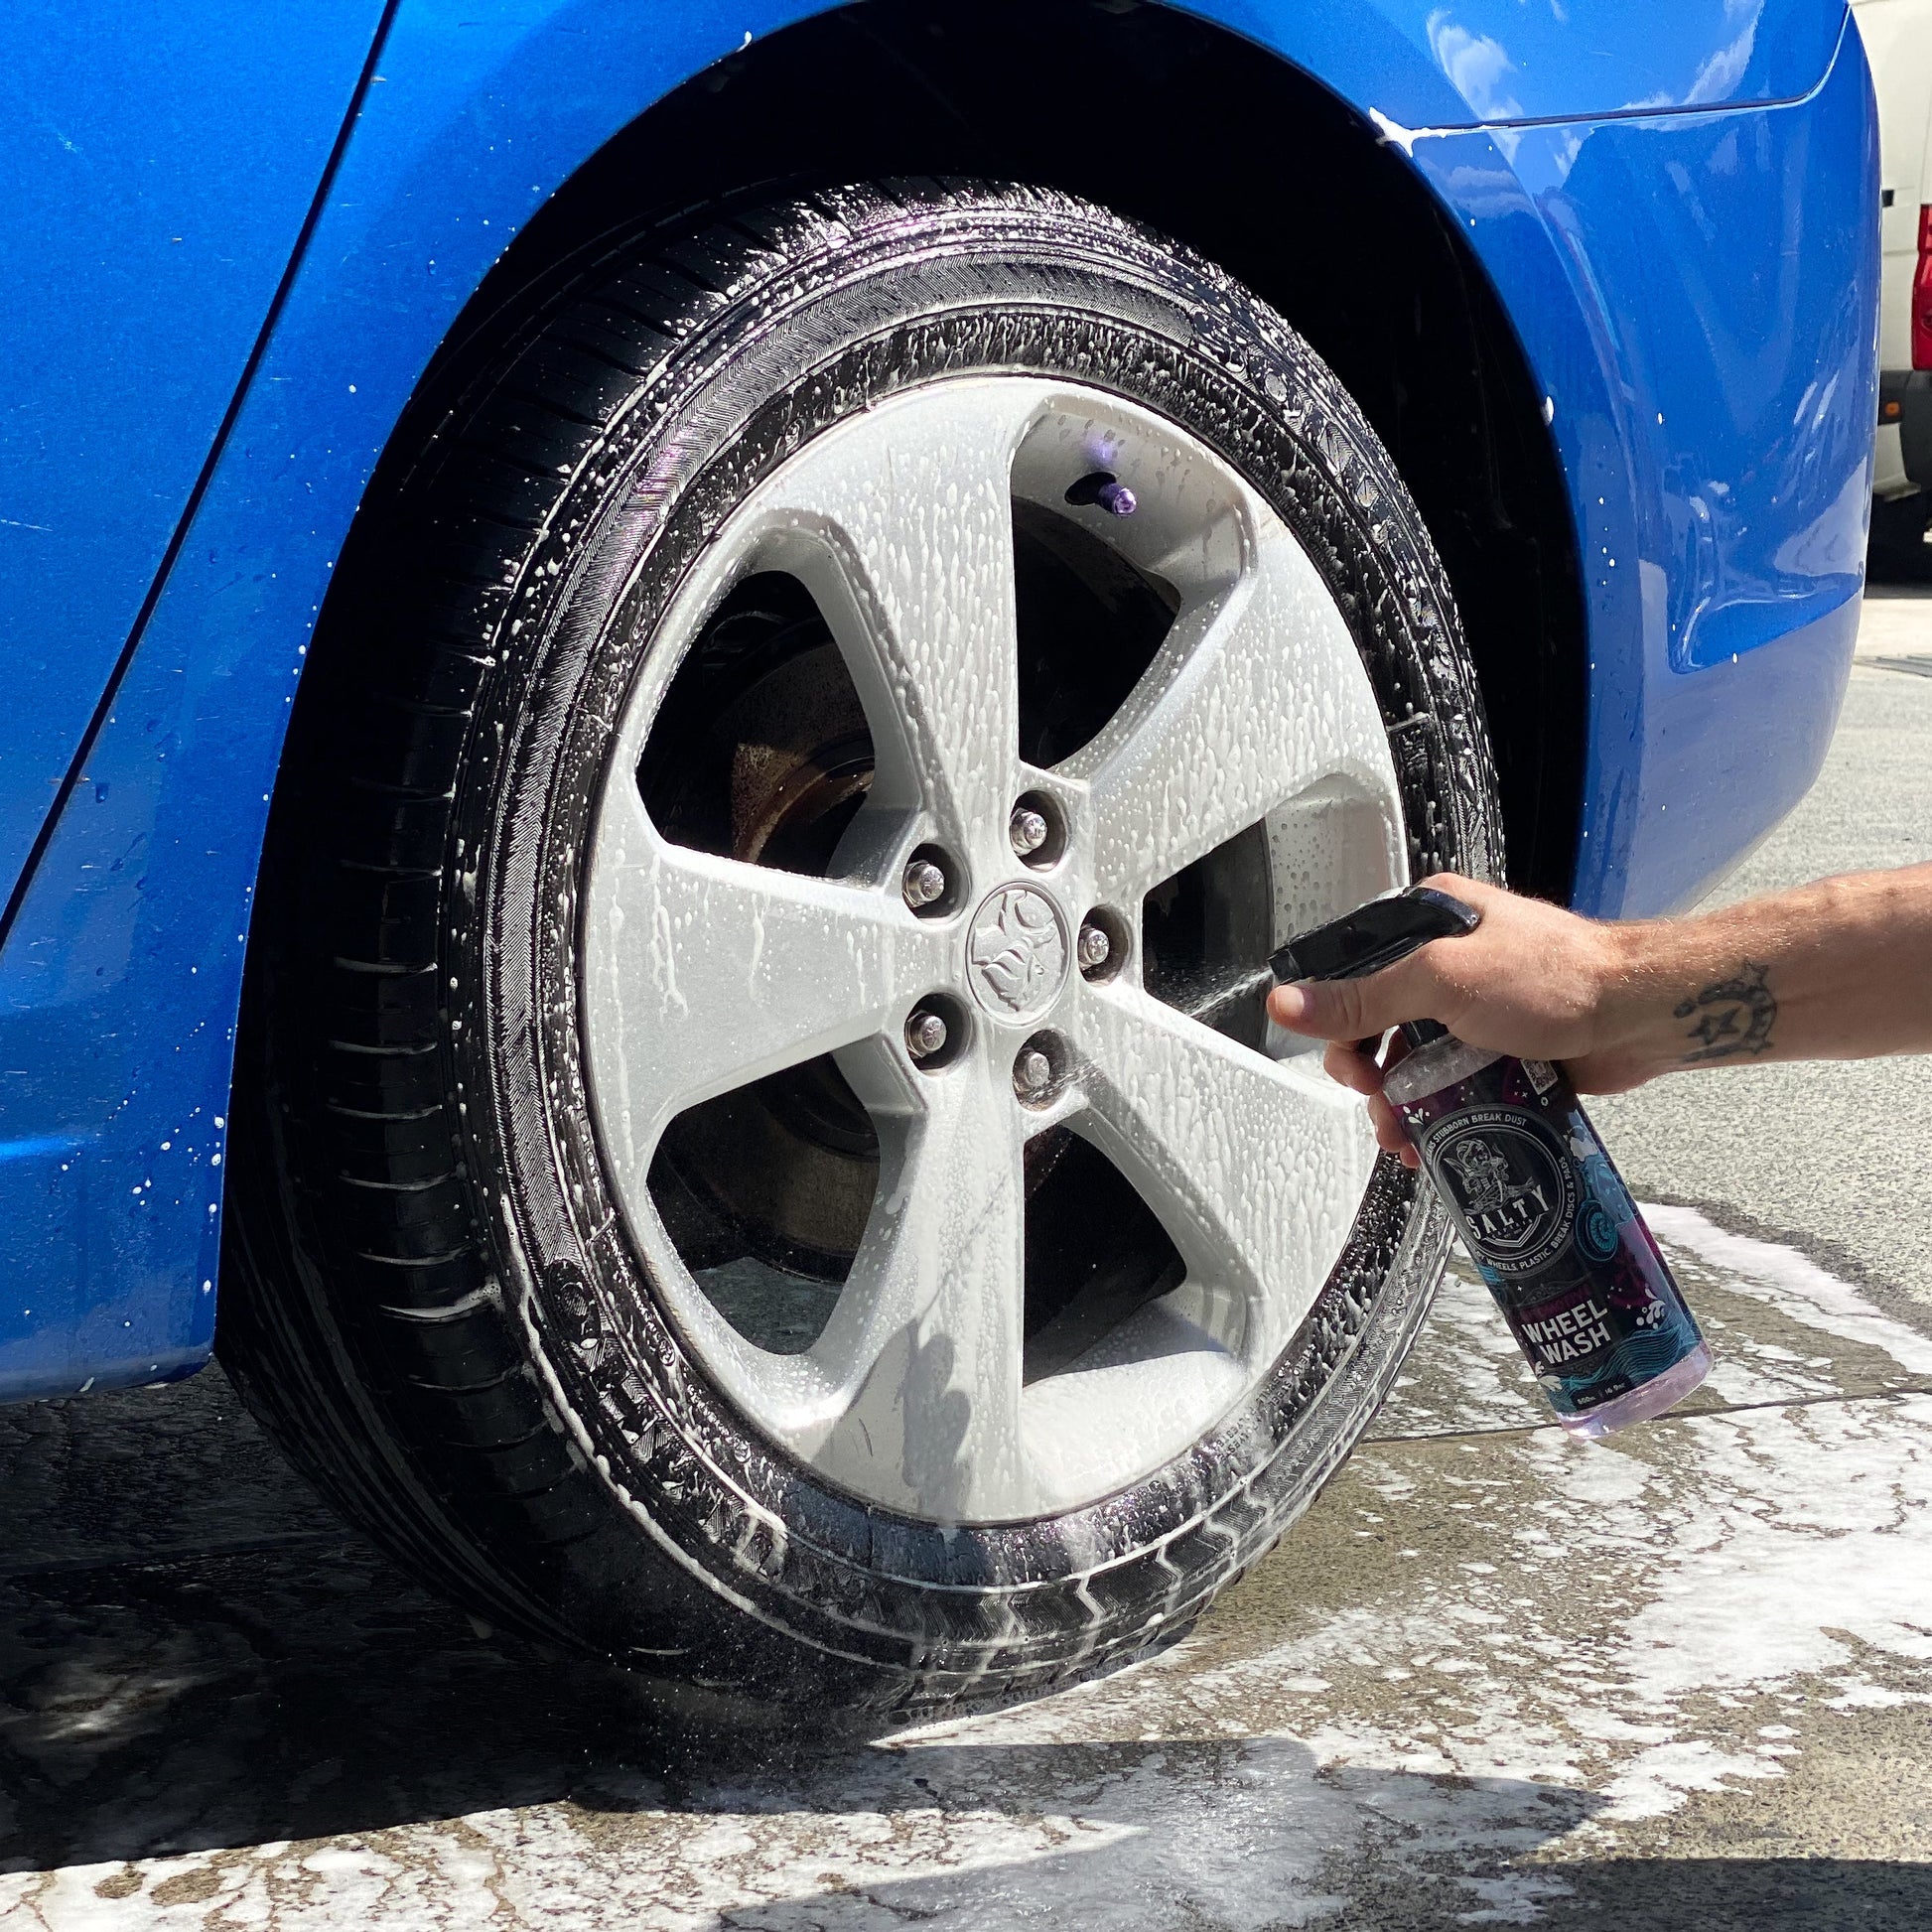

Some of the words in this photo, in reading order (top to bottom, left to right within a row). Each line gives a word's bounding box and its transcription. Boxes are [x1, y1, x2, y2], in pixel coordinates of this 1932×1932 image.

[1433, 1117, 1469, 1144] STUBBORN
[1471, 1113, 1503, 1124] BREAK
[1504, 1114, 1528, 1127] DUST
[1558, 1156, 1573, 1180] PADS
[1464, 1184, 1549, 1240] SALTY
[1566, 1191, 1576, 1219] DISCS
[1551, 1220, 1572, 1249] BREAK
[1521, 1299, 1608, 1343] WHEEL
[1539, 1320, 1611, 1365] WASH
